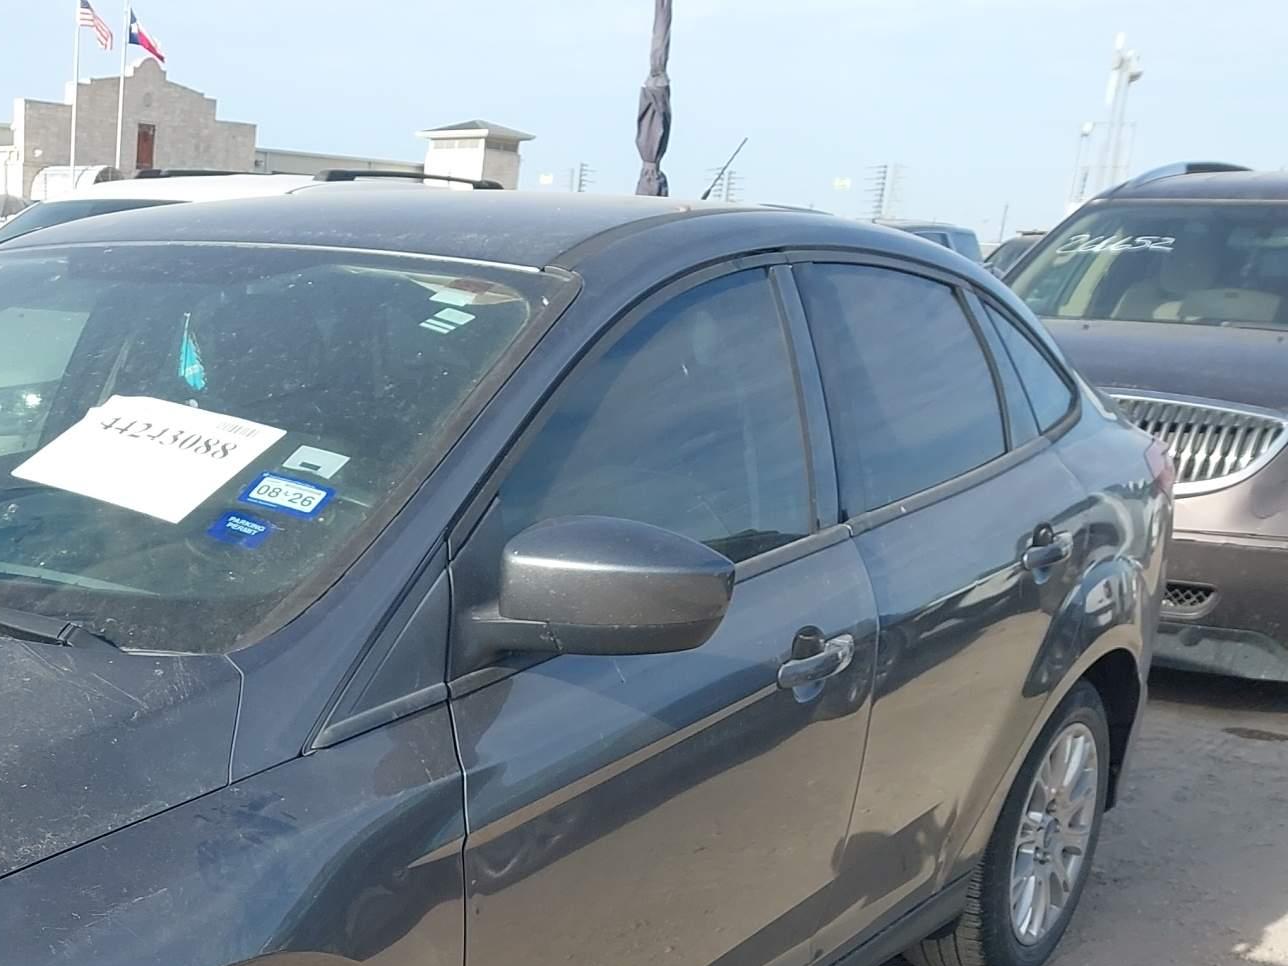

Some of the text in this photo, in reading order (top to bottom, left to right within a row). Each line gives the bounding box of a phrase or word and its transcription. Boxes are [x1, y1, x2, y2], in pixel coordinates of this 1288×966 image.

[99, 416, 238, 460] 44243088
[225, 521, 259, 536] PERMIT
[228, 516, 267, 532] PARKING
